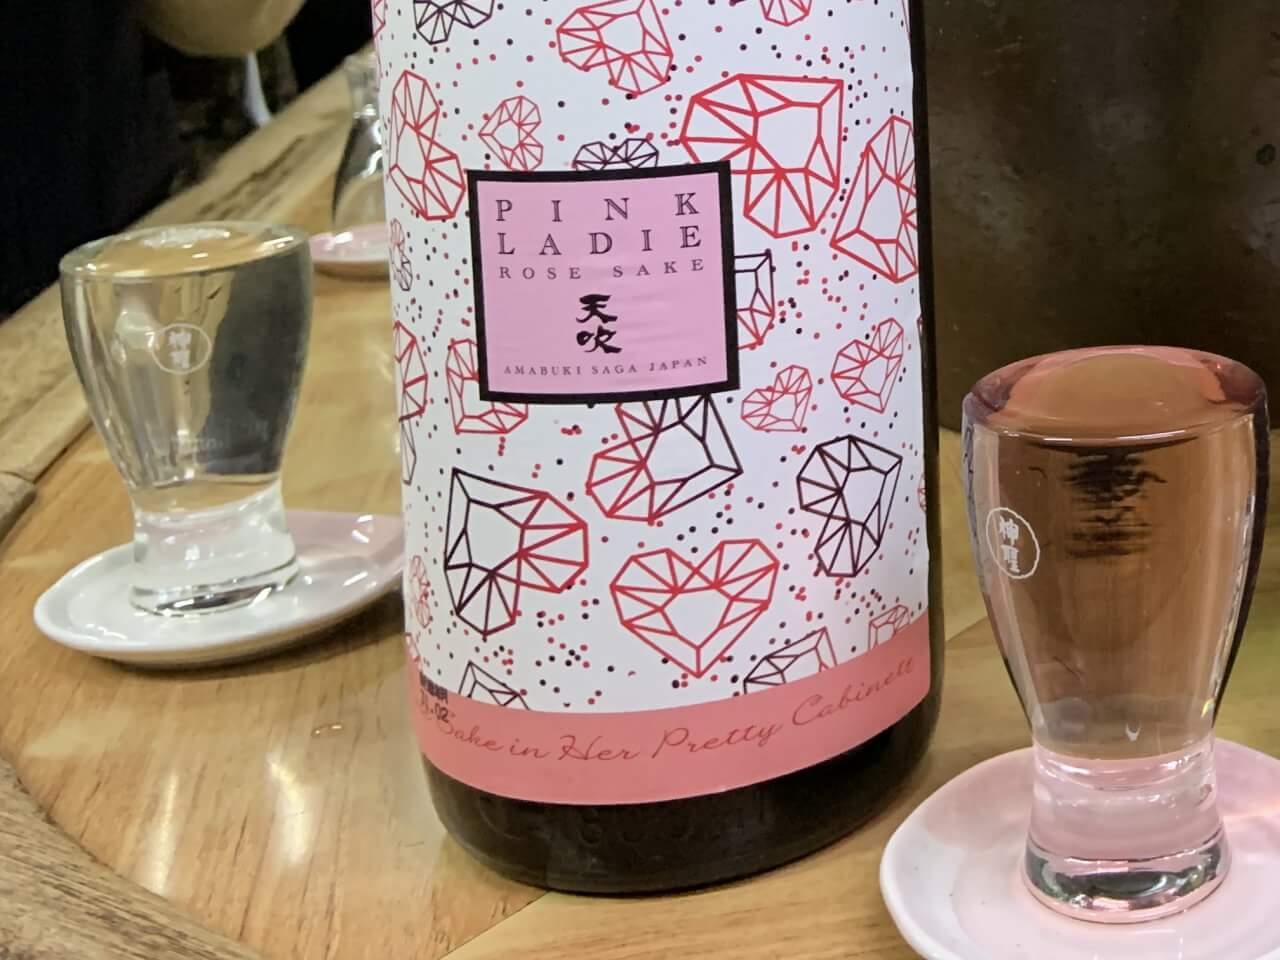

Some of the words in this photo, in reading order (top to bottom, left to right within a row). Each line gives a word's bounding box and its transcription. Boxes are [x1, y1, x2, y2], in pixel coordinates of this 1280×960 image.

[495, 192, 699, 222] PINK
[498, 225, 702, 256] LADIE
[499, 266, 582, 280] ROSE
[612, 258, 704, 278] SAKE
[575, 293, 622, 354] 天吹
[503, 364, 582, 376] AMABUKI
[591, 363, 638, 375] SAGA
[649, 356, 707, 372] JAPAN
[556, 735, 640, 762] Her
[650, 722, 785, 759] Pretty
